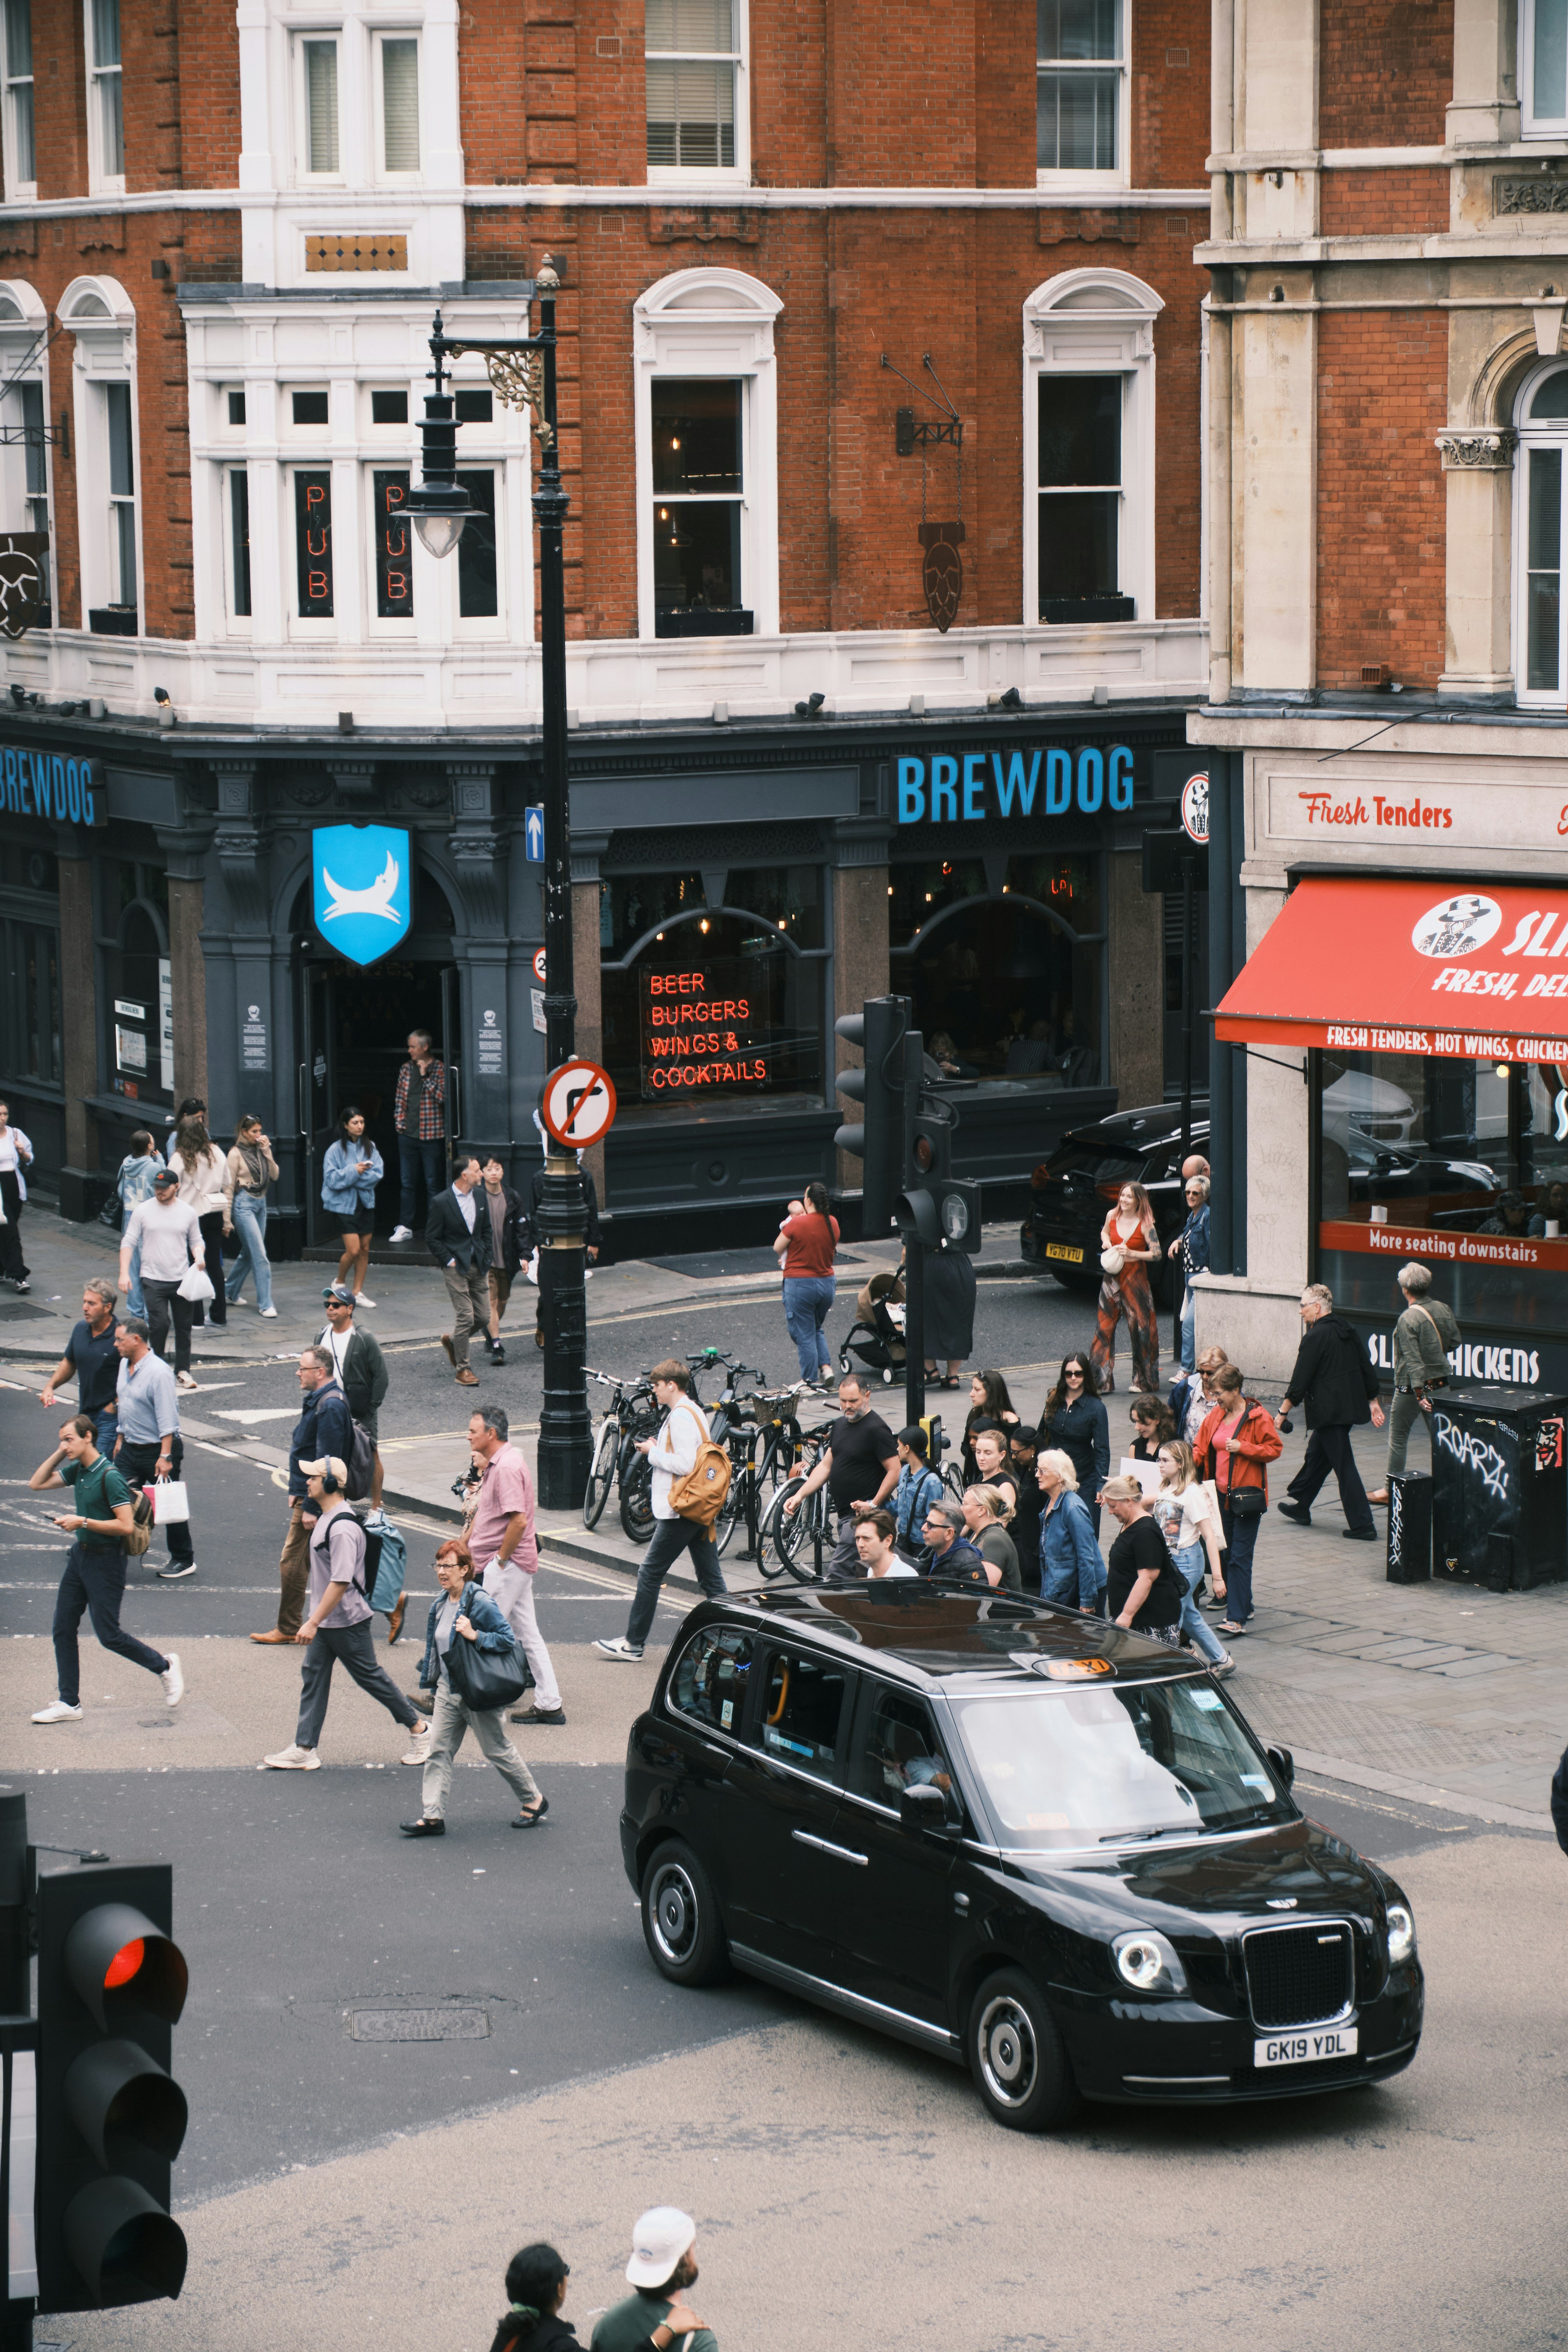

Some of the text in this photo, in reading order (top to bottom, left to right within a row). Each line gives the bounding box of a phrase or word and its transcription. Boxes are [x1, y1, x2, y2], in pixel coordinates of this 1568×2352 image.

[307, 487, 327, 597] PUB
[386, 487, 406, 598] PUB
[898, 746, 1133, 823] BREWDOG
[1298, 792, 1452, 828] Fresh Tenders
[1502, 911, 1568, 957] SLI
[538, 958, 546, 971] 2
[651, 973, 704, 995] BEER
[1431, 968, 1568, 1000] FRESH, DEL
[652, 1000, 749, 1026] BURGERS
[651, 1032, 738, 1057] WINGS &
[1328, 1026, 1367, 1047] FRESH
[1370, 1029, 1432, 1055] TENDERS,
[1435, 1033, 1462, 1053] HOT
[1464, 1035, 1513, 1060] WINGS,
[653, 1060, 766, 1088] COCKTAILS
[1049, 1245, 1080, 1260] YG70 VTU
[1370, 1229, 1537, 1262] More seating downstairs
[1368, 1333, 1539, 1384] SL HICKENS
[1498, 1421, 1518, 1441] SALTY
[1054, 1660, 1105, 1674] TAXI
[1267, 2035, 1346, 2061] GK19 YDL
